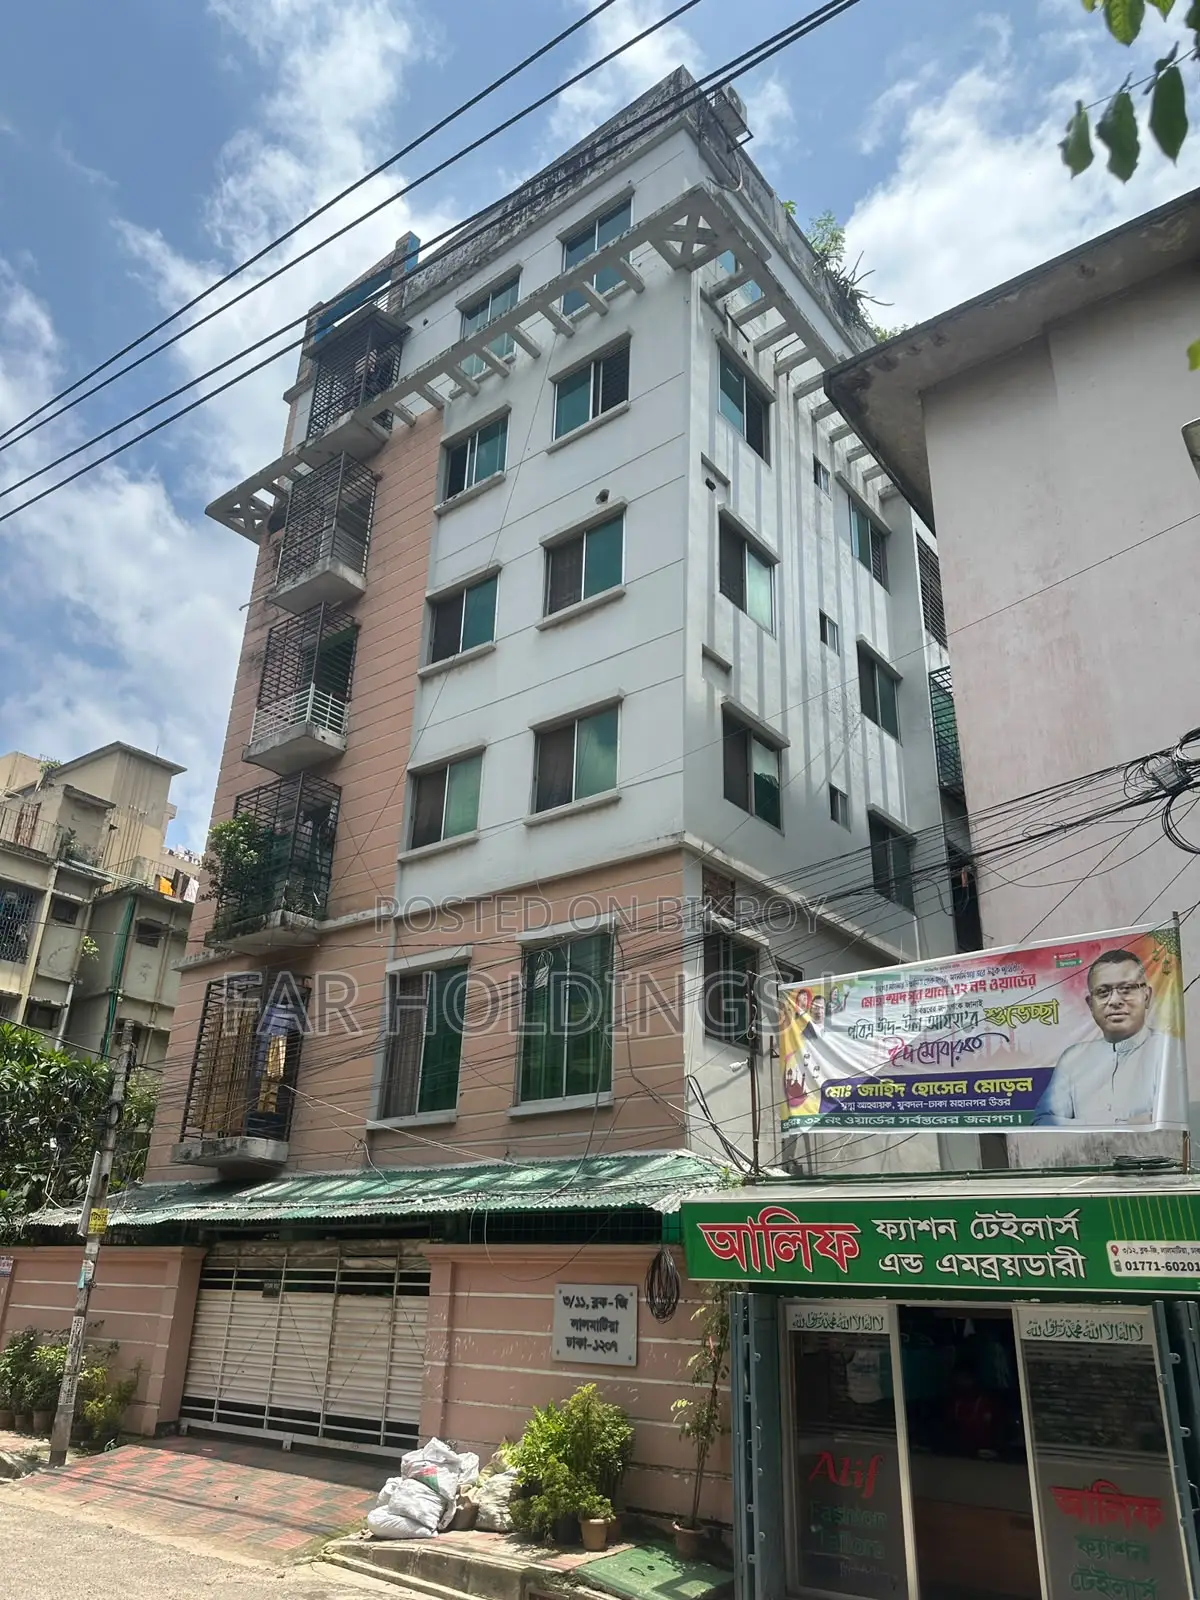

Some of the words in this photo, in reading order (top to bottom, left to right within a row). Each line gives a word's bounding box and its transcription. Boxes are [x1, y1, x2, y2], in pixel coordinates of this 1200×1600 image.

[983, 999, 1060, 1029] শুভেচ্ছা
[857, 1078, 905, 1099] জাহিদ
[911, 1080, 968, 1097] হোসেন
[973, 1077, 1033, 1097] মোড়ল
[949, 1098, 986, 1108] মহানগর
[988, 1096, 1011, 1107] উত্তর
[824, 1116, 843, 1126] নং
[844, 1114, 896, 1126] ওয়ার্ডের
[697, 1206, 862, 1274] আলিফ
[871, 1216, 957, 1242] ফ্যাশন
[969, 1208, 1082, 1244] টেইলার্স
[878, 1253, 924, 1276] এন্ড
[935, 1245, 1087, 1282] এমব্রয়ডারী
[569, 1316, 620, 1334] লালমাটিয়া
[565, 1336, 619, 1354] ঢাকা-১২০৭
[808, 1450, 885, 1499] Alif
[1048, 1479, 1166, 1532] আলিফ
